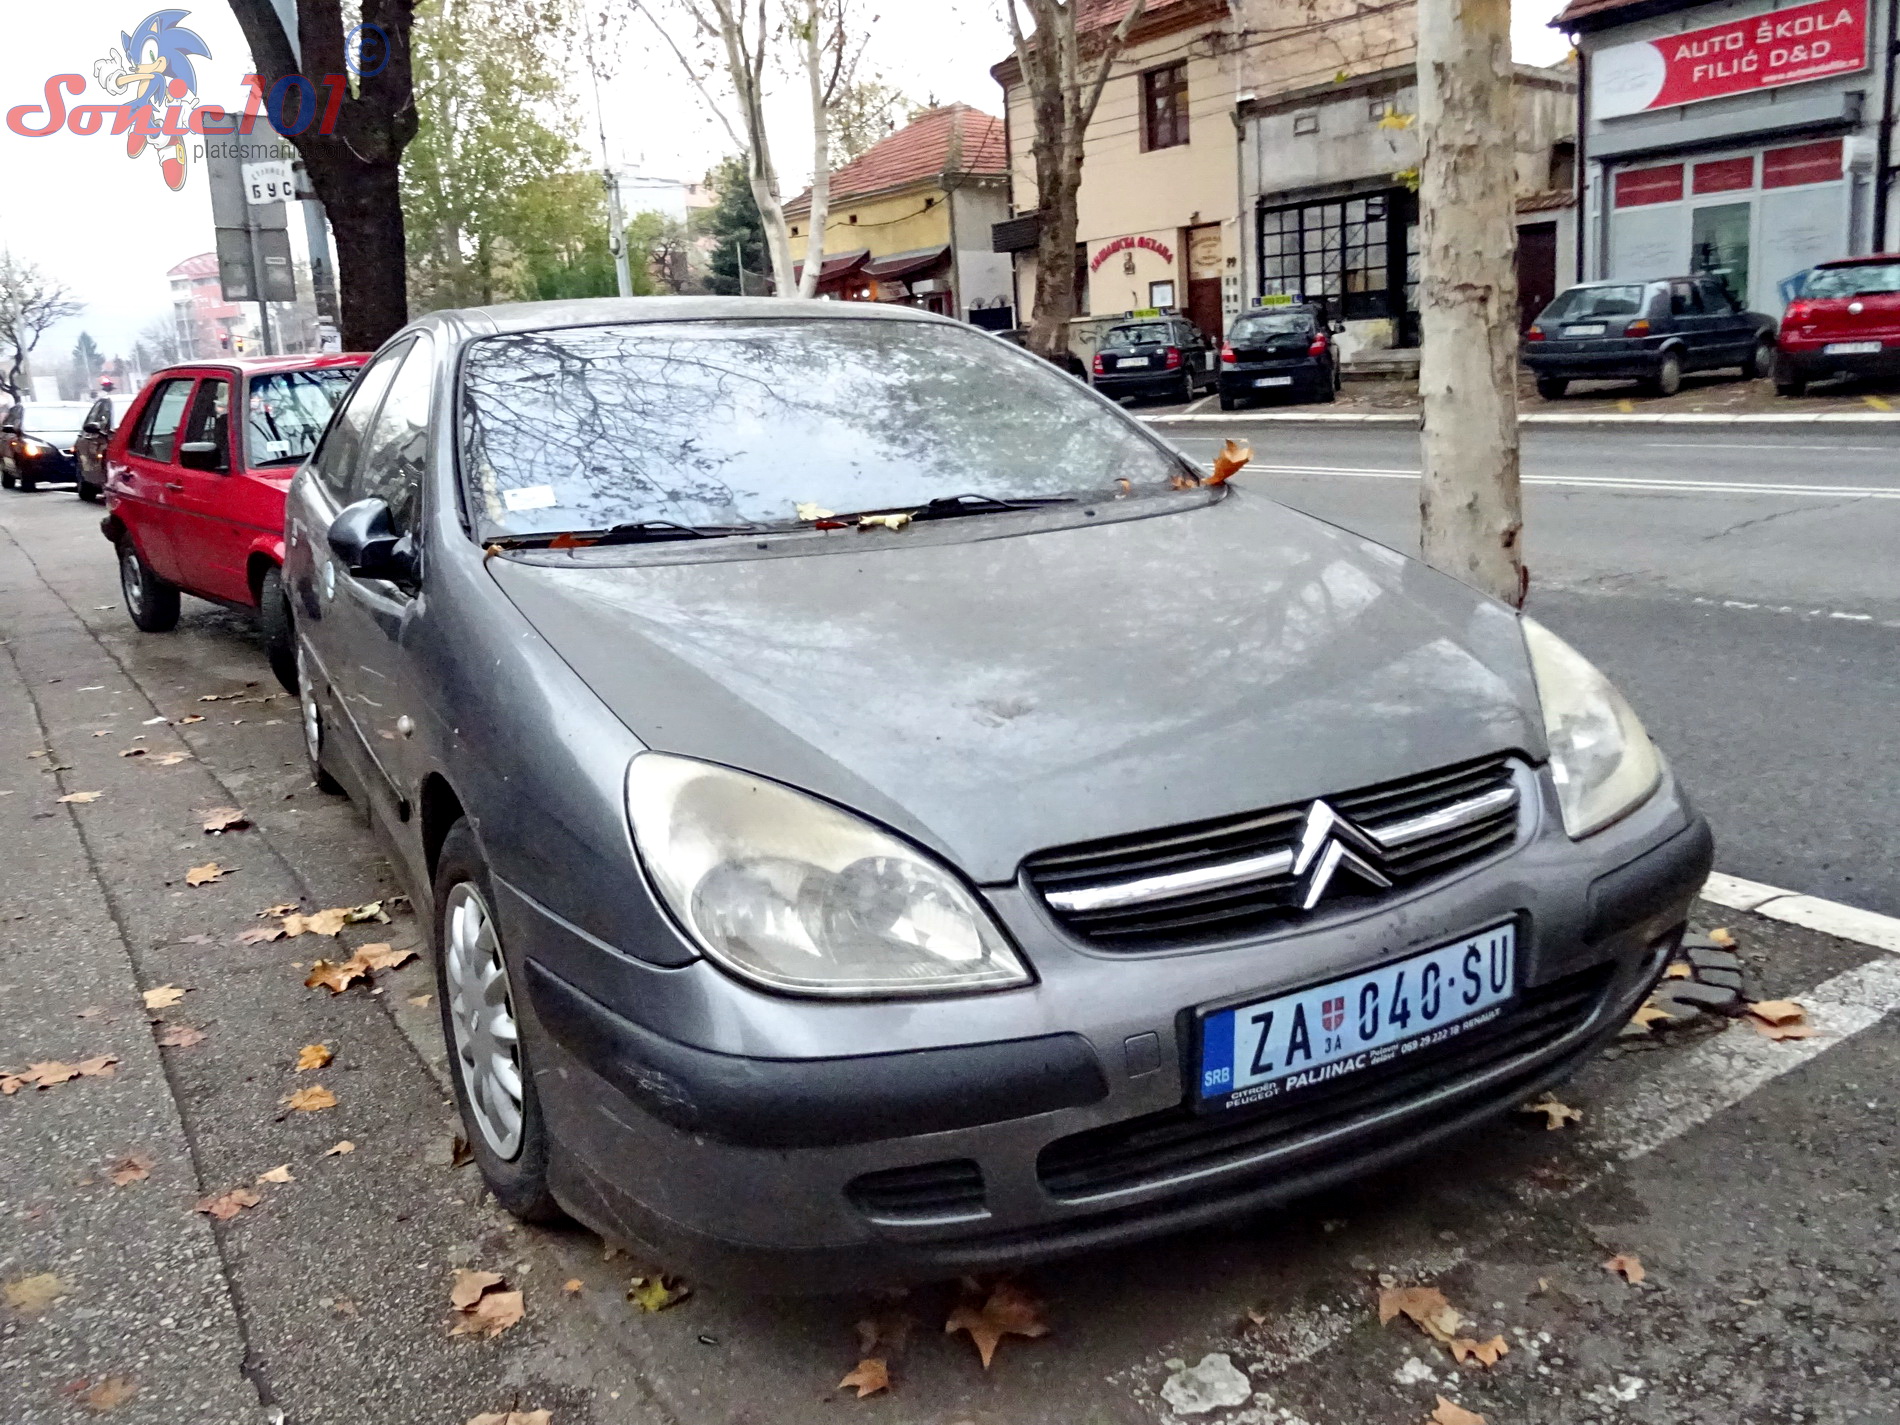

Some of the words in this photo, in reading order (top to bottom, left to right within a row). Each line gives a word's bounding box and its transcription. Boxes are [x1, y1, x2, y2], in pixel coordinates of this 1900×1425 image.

[1673, 31, 1744, 63] AUTO
[1755, 8, 1854, 45] ŠKOLA
[1692, 49, 1759, 83] FILIĆ
[1769, 40, 1832, 68] D&D
[252, 181, 293, 199] БУС
[1463, 1007, 1501, 1031] RENAULT
[1250, 1002, 1312, 1076] ZA
[1204, 1067, 1230, 1087] SRB
[1285, 1054, 1367, 1092] PALJINAC
[1225, 1088, 1280, 1109] PEUGEOT
